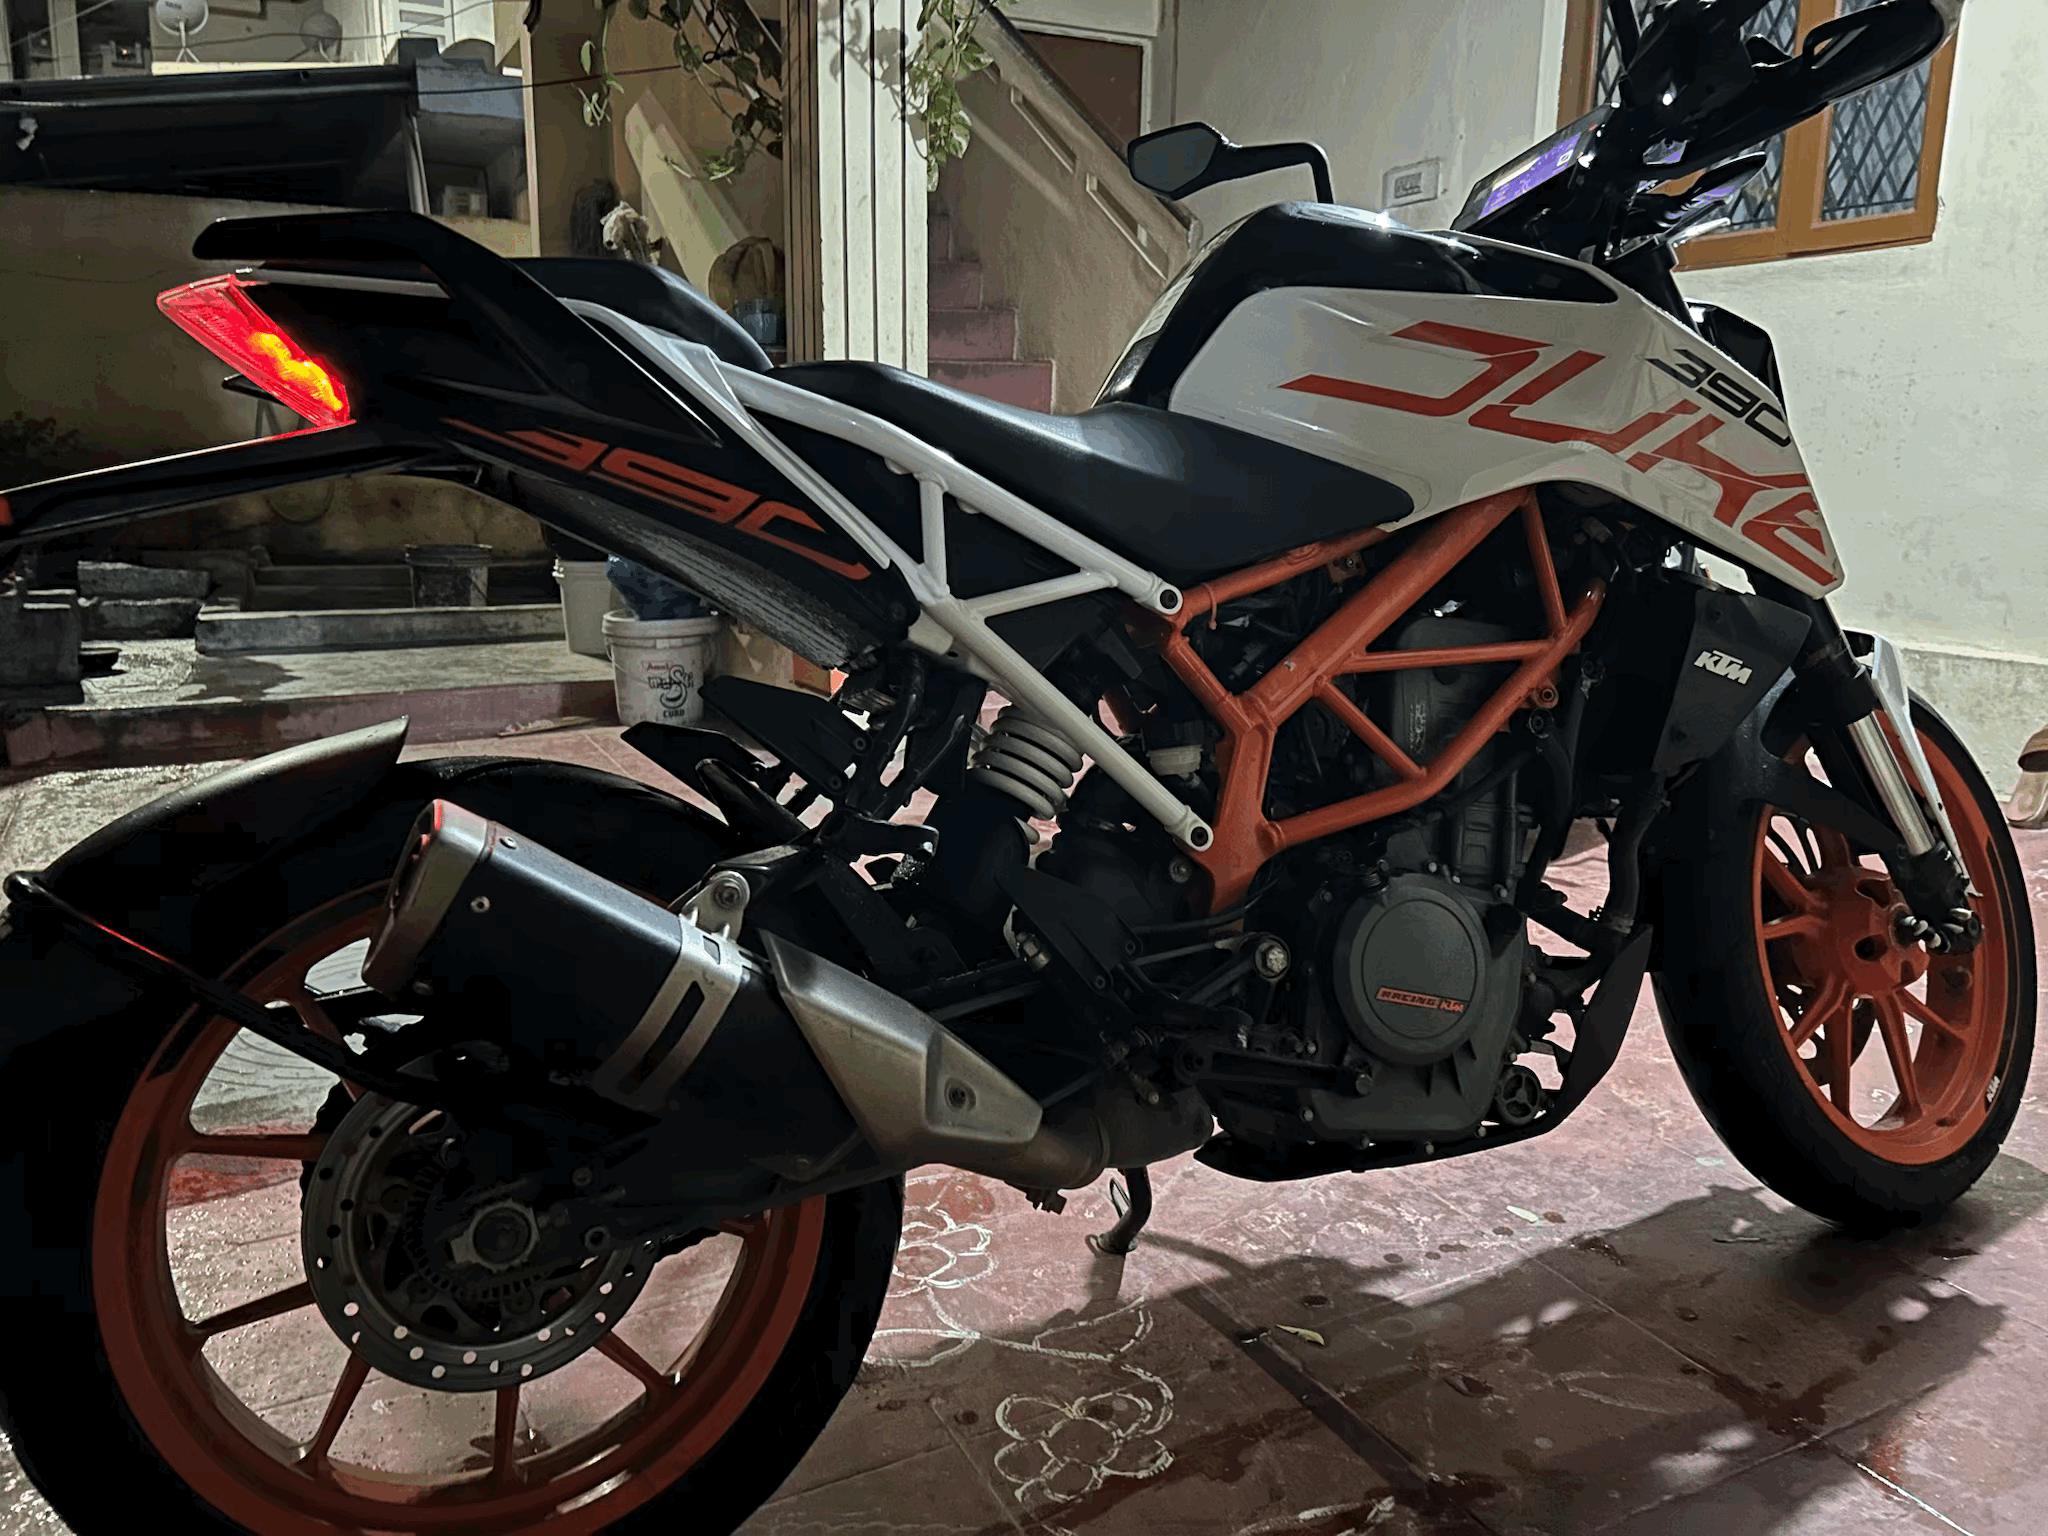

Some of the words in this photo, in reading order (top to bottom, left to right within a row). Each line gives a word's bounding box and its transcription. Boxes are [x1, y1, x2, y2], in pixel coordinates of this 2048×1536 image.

[1643, 347, 1792, 448] 390
[1278, 320, 1838, 586] DUKE
[1693, 649, 1753, 685] KTM
[1380, 989, 1437, 1006] RACING
